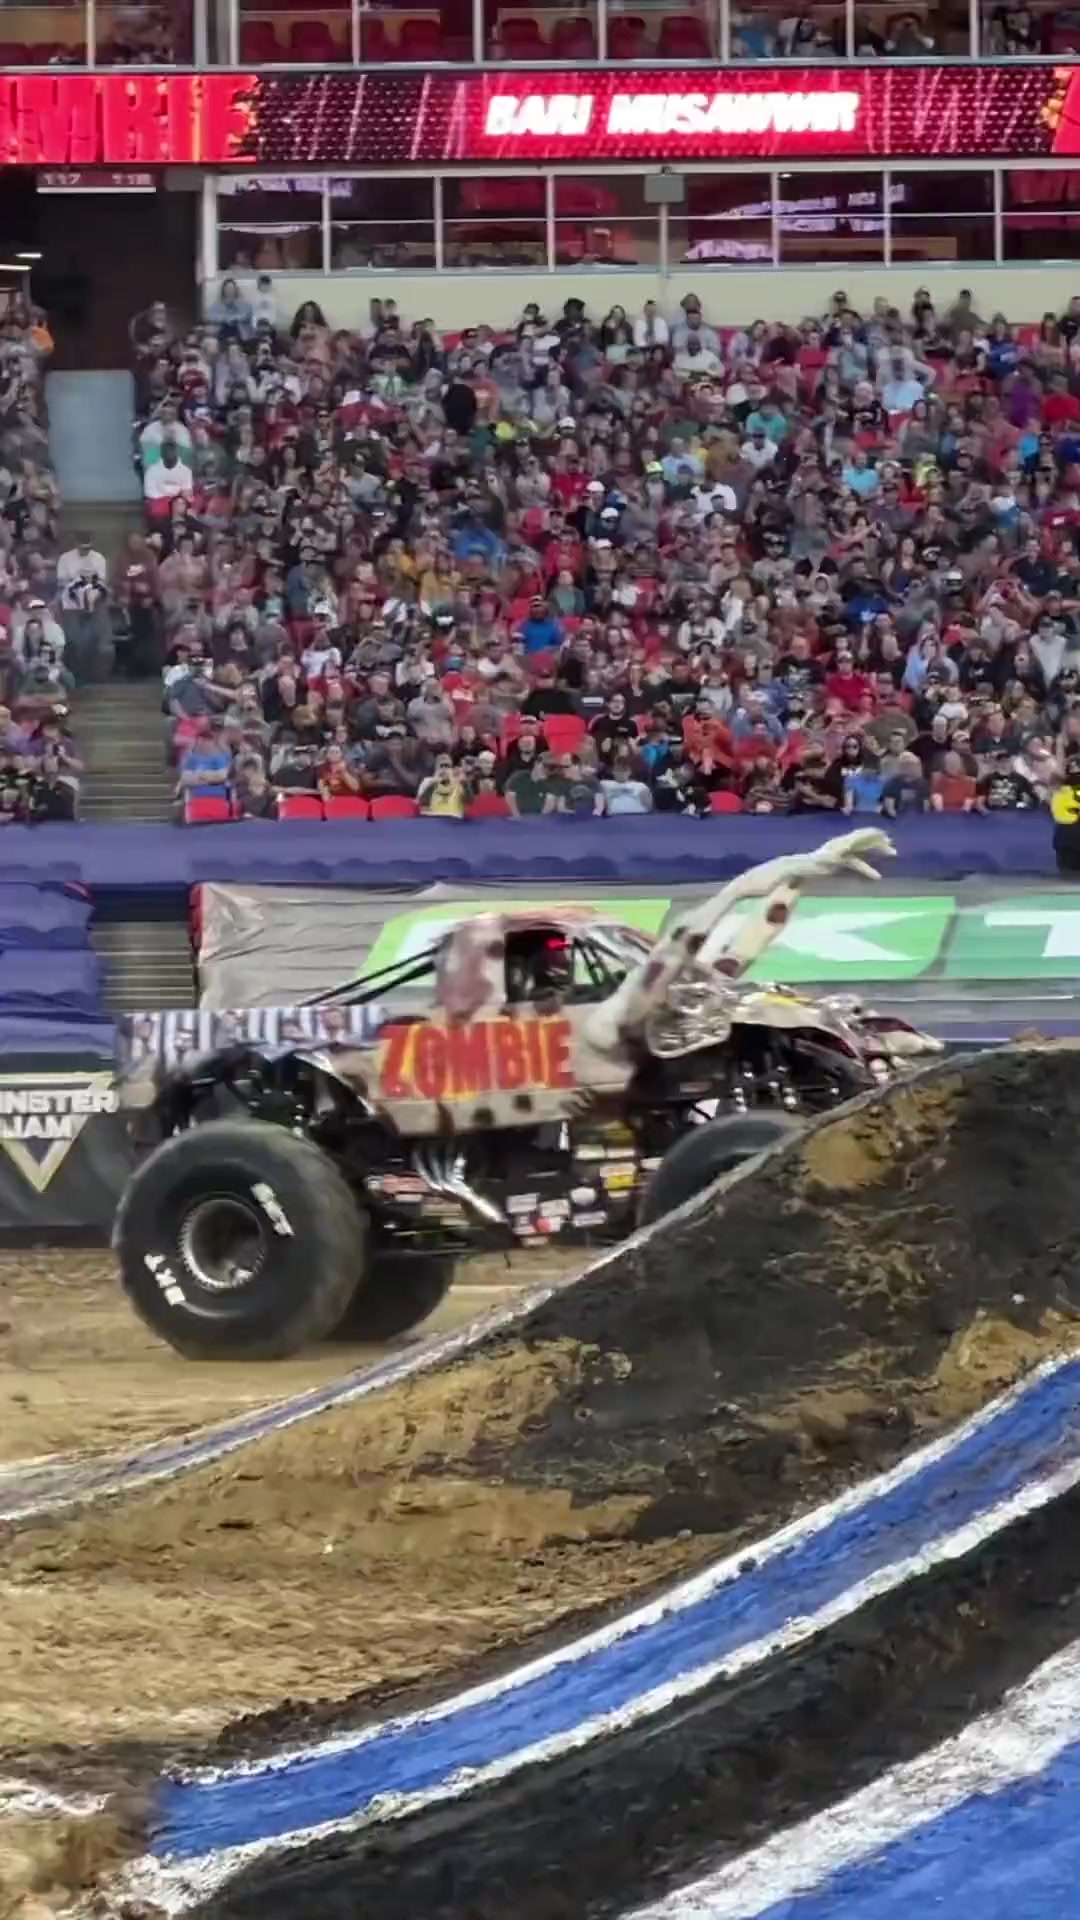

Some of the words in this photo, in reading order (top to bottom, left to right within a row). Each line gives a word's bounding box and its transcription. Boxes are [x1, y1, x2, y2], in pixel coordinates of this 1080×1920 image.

[485, 95, 594, 136] BARI
[379, 1021, 576, 1099] ZOMBIE
[0, 1090, 119, 1113] NSTER
